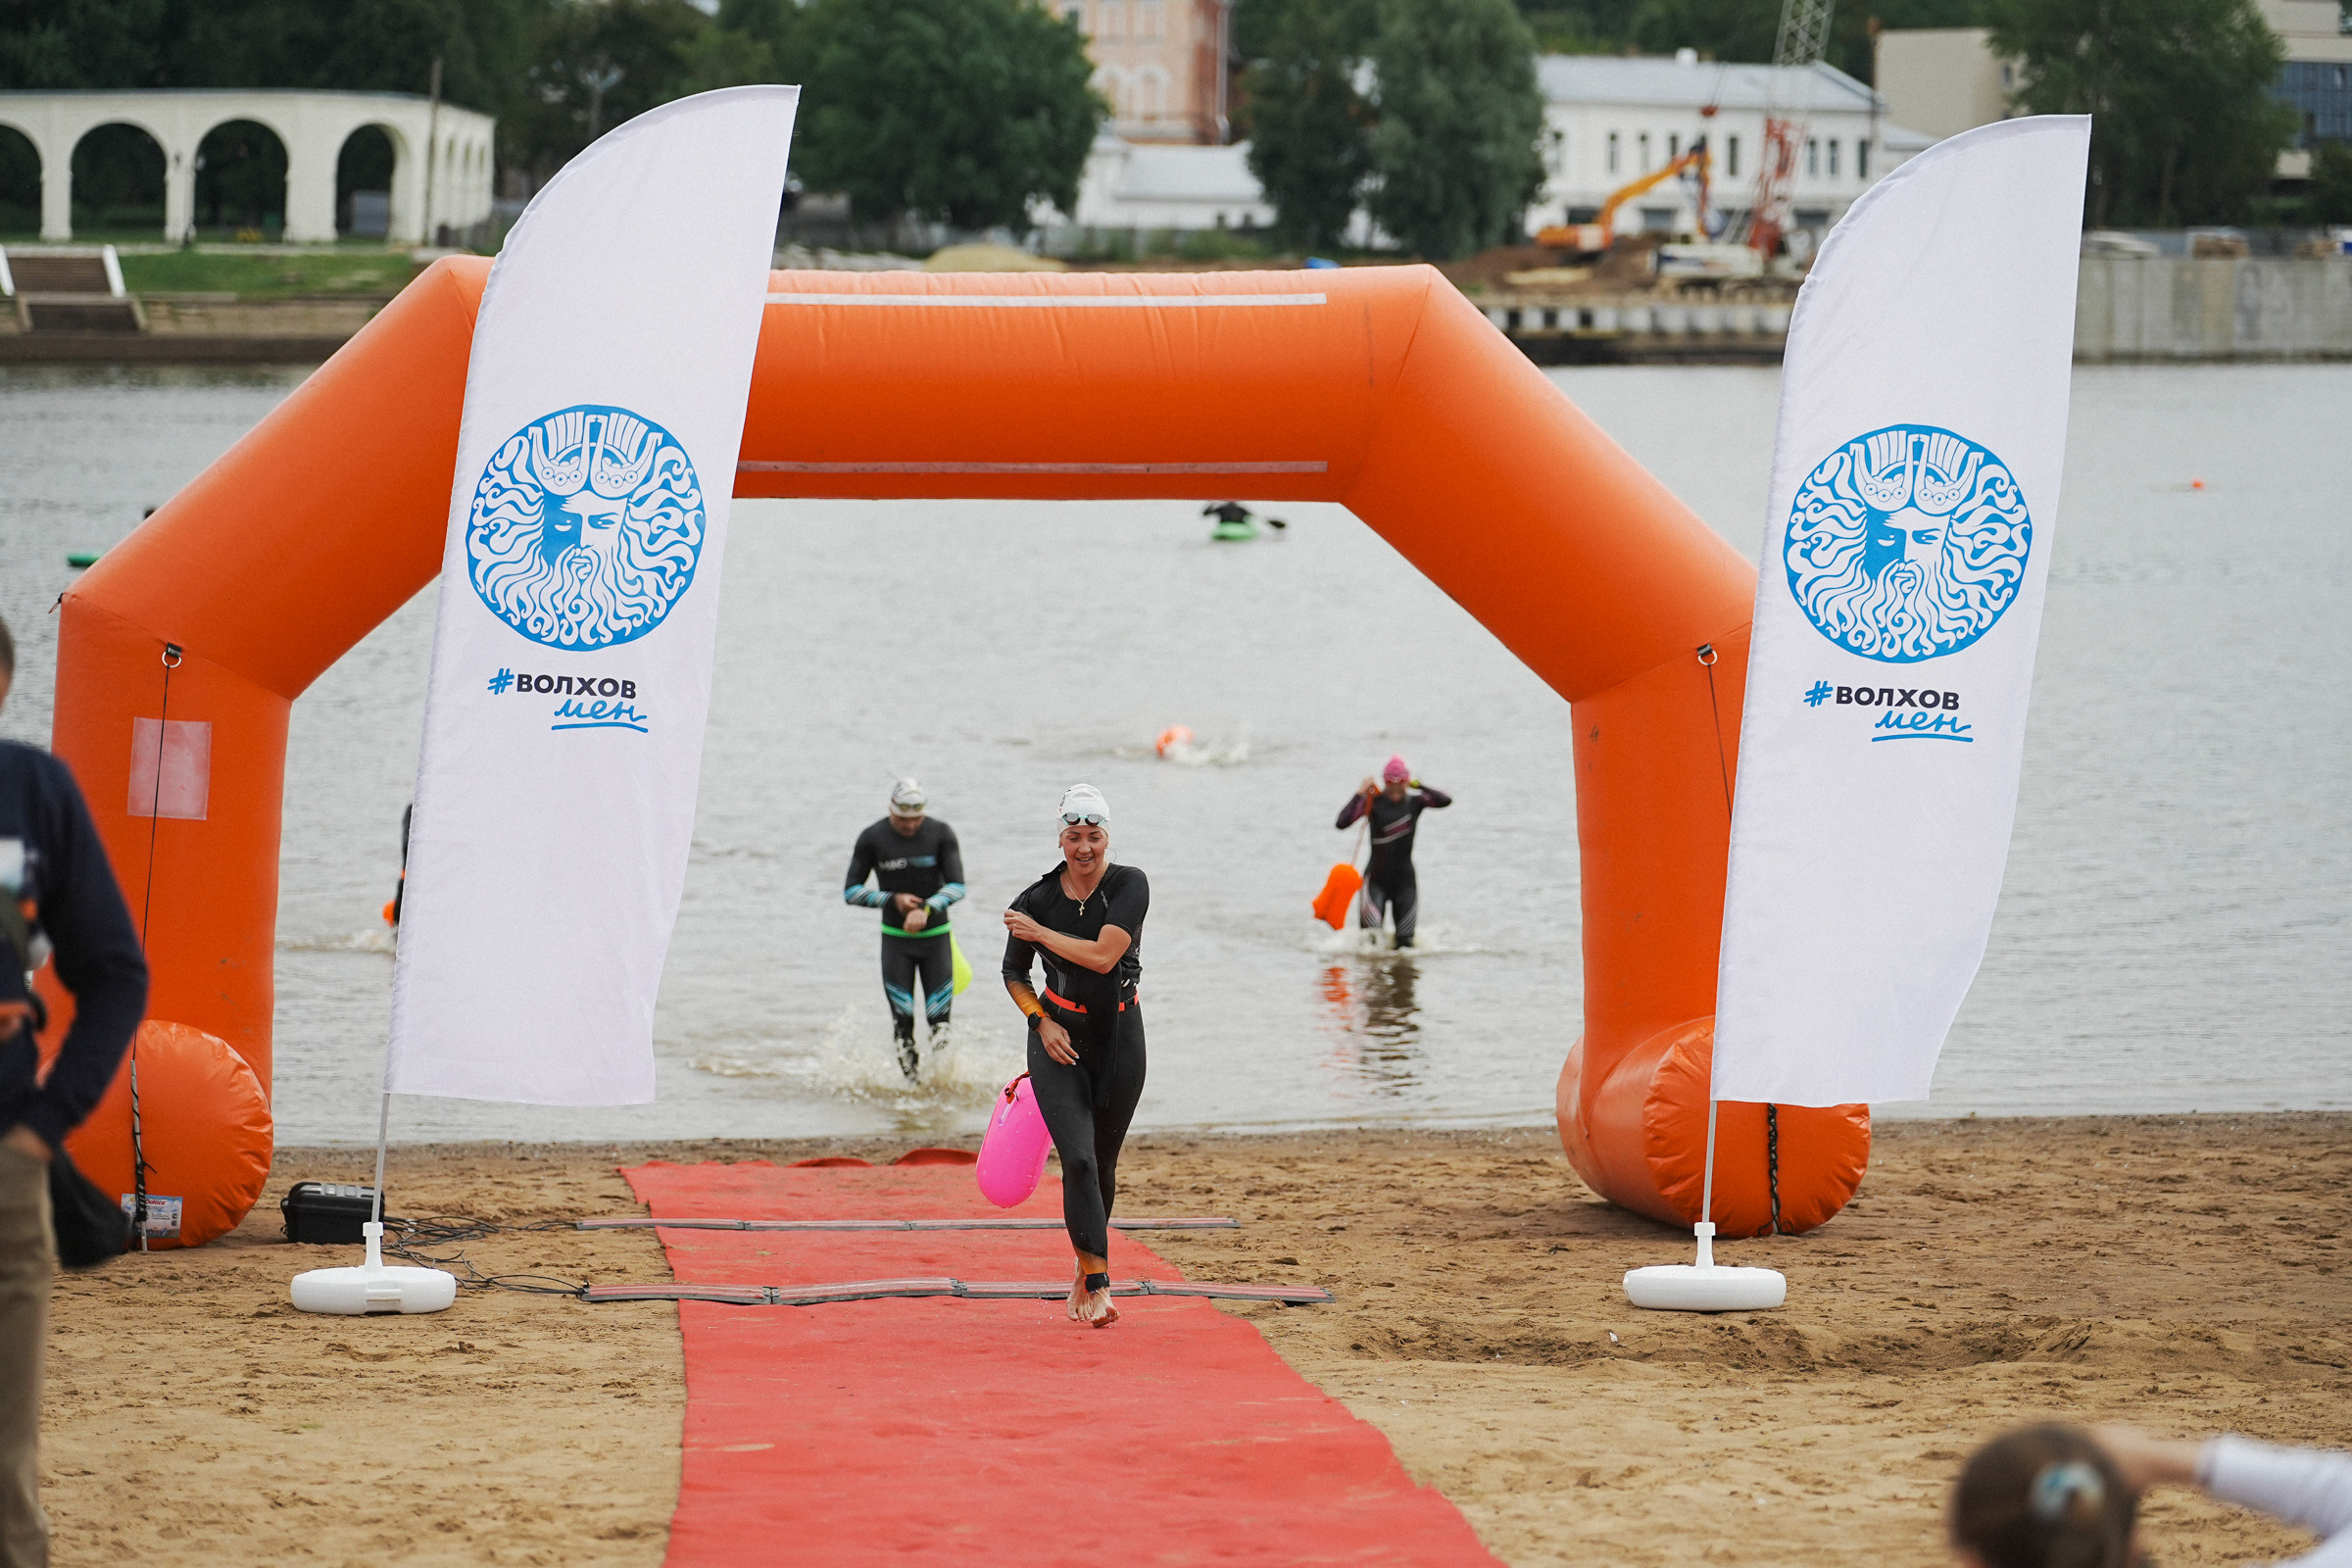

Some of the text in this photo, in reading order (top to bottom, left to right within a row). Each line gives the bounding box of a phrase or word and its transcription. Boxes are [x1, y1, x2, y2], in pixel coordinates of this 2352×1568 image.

[487, 668, 636, 699] #ВОЛХОВ
[1803, 680, 1960, 710] #ВОЛХОВ
[554, 699, 648, 721] мен
[1875, 710, 1972, 733] мен
